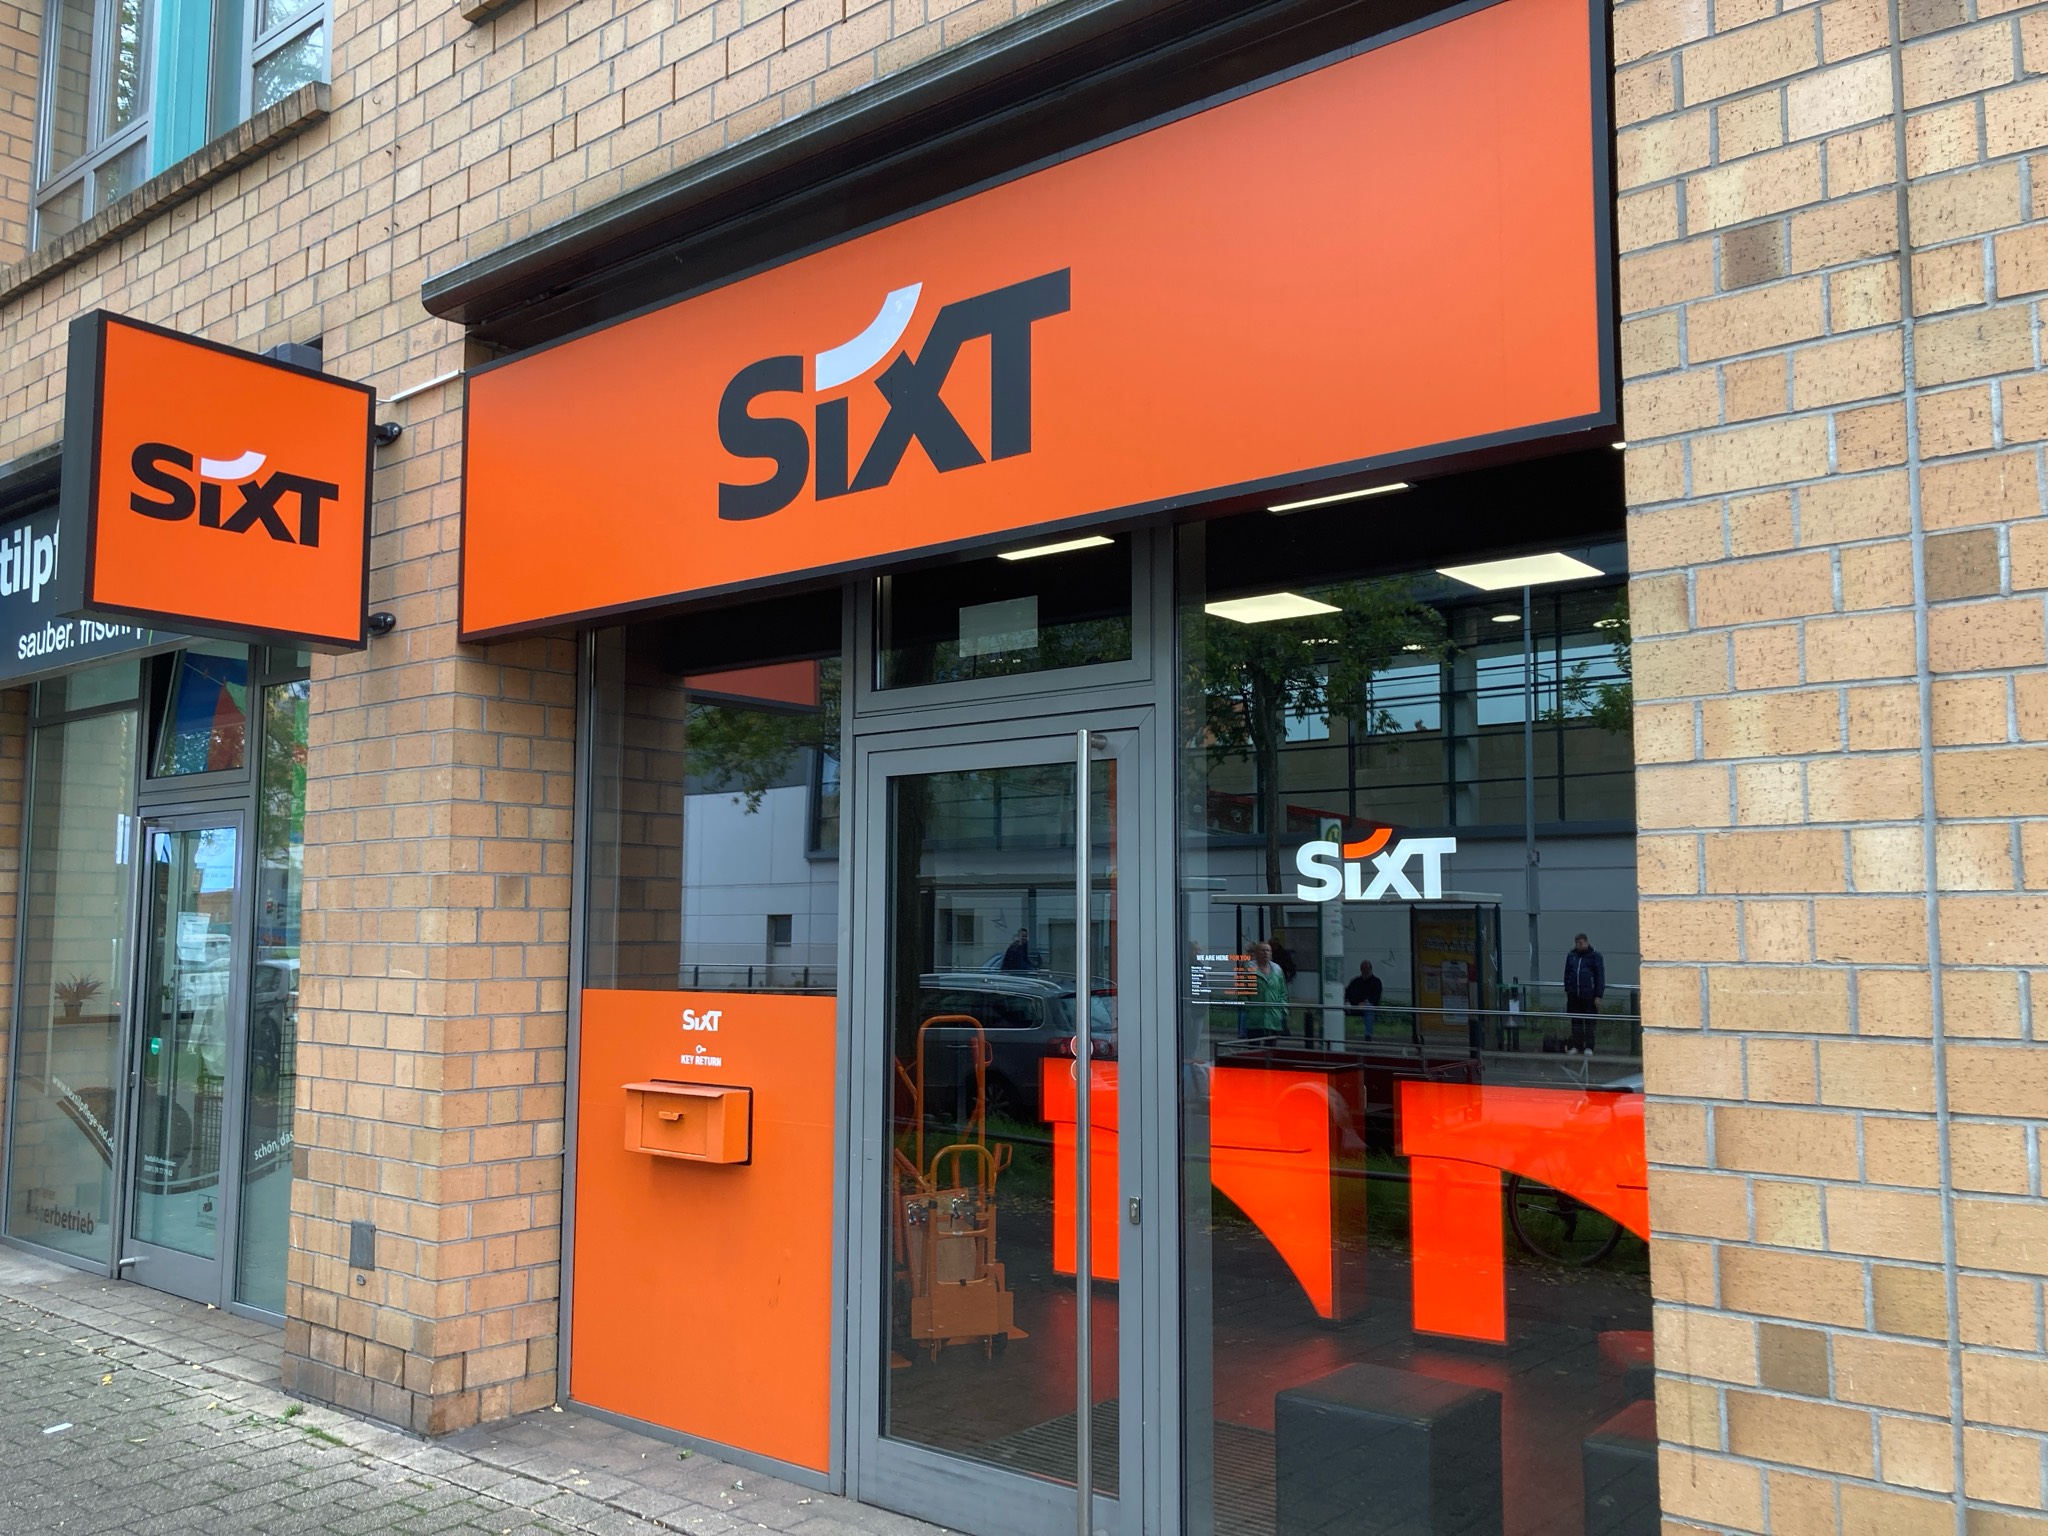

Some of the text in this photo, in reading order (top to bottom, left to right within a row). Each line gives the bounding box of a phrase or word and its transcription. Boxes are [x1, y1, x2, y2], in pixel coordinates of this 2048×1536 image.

[18, 621, 74, 659] sauber.
[681, 1054, 721, 1066] KEY RETURN
